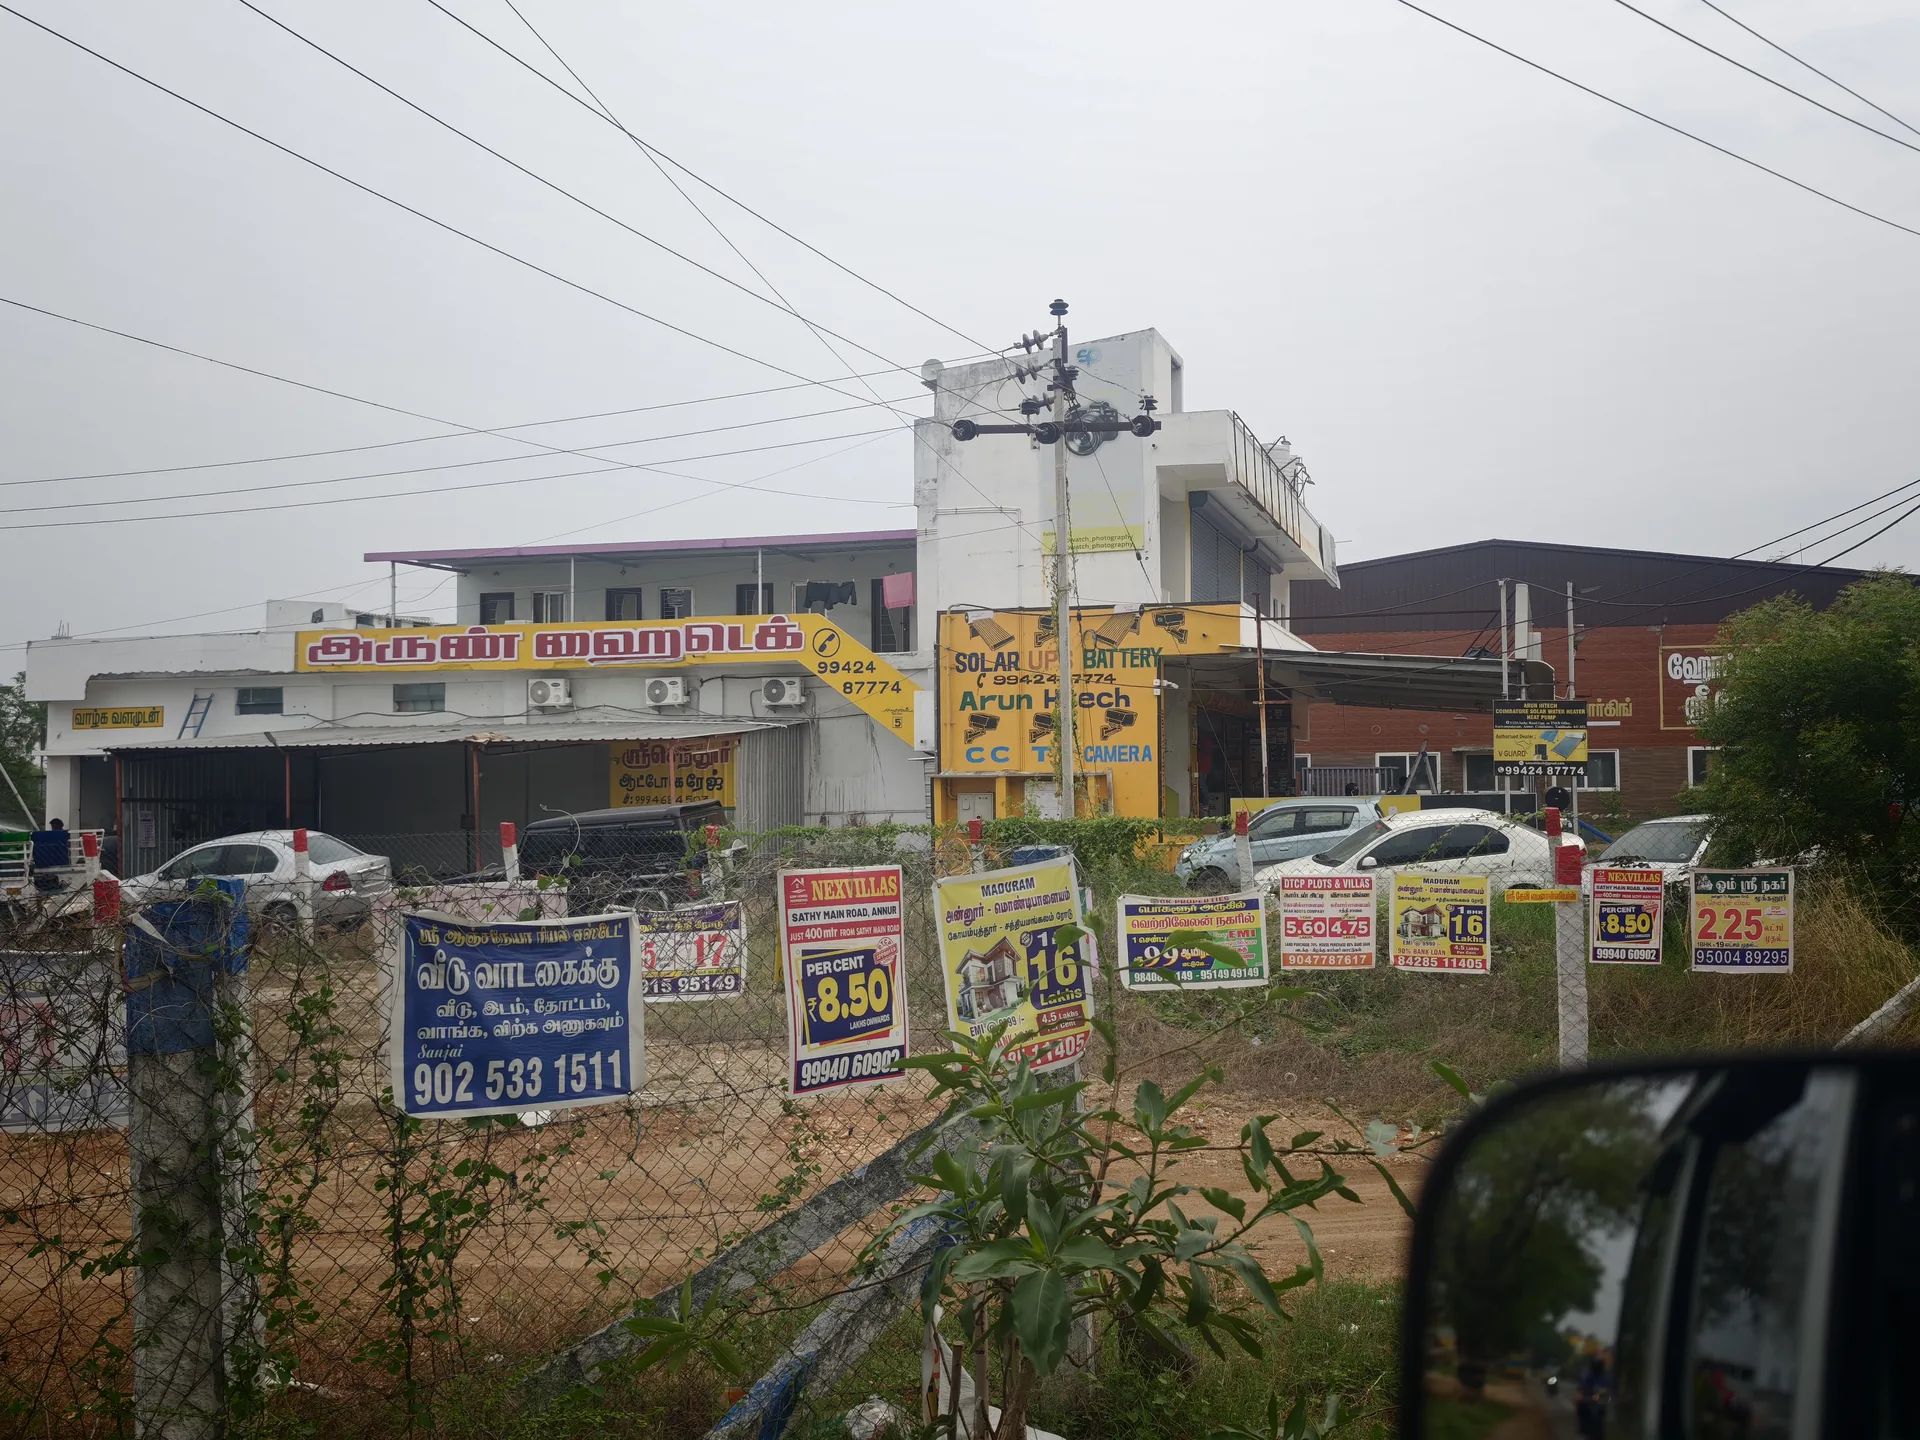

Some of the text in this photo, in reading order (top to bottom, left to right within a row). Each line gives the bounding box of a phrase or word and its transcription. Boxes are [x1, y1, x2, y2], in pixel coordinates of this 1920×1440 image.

[307, 614, 806, 666] அருண் ஹைடெக்
[817, 660, 876, 674] 99424
[955, 651, 1020, 673] SOLAR
[1083, 647, 1164, 669] BATTERY
[842, 681, 902, 694] 87774
[993, 673, 1116, 686] 994247774
[959, 691, 1032, 711] Arun
[1588, 697, 1633, 717] ார்கிங்
[75, 707, 160, 728] வாழ்க வளமுடன்
[1084, 744, 1153, 763] CAMERA
[1505, 766, 1584, 775] 99424 87774
[1284, 878, 1370, 889] DTCP PLOTS & VILLAS
[1608, 871, 1660, 883] NEXVILLAS
[811, 876, 898, 901] NEXVILLAS
[981, 877, 1036, 897] MADURAM
[1715, 877, 1787, 894] ஓம் ஸ்ரீ நகர்
[792, 906, 897, 922] SATHY MAIN ROAD, ANNUR
[945, 902, 984, 927] அன்னூர்
[1457, 906, 1465, 914] 1
[1601, 906, 1616, 914] PER
[1131, 912, 1256, 931] வெற்றிவேலன் நகரில்
[1286, 920, 1369, 935] 5.60 4.75
[1451, 914, 1483, 936] 16
[1697, 908, 1763, 941] 2.25
[790, 932, 804, 942] JUST
[805, 928, 823, 940] 400
[823, 926, 838, 938] mtr
[840, 929, 856, 937] FROM
[1228, 929, 1257, 939] EMI
[1455, 935, 1484, 943] Lakhs
[1144, 946, 1179, 968] 99
[1288, 954, 1367, 965] 9047787617
[1397, 956, 1483, 968] 84285 11405
[1596, 948, 1657, 960] 99940 60902
[1696, 950, 1788, 964] 95004 89295
[417, 946, 620, 995] வீடு வாடகைக்கு
[806, 955, 865, 977] PER CENT
[1029, 945, 1079, 991] 16
[1200, 967, 1260, 980] 95149 49149
[849, 1018, 866, 1030] LAKHS
[1041, 1010, 1079, 1024] 4.5 Lakhs
[493, 1018, 539, 1040] விற்க
[969, 1024, 985, 1037] EMI
[418, 1044, 464, 1061] Sanjai
[414, 1049, 622, 1106] 902 533 1511
[801, 1057, 849, 1087] 99940
